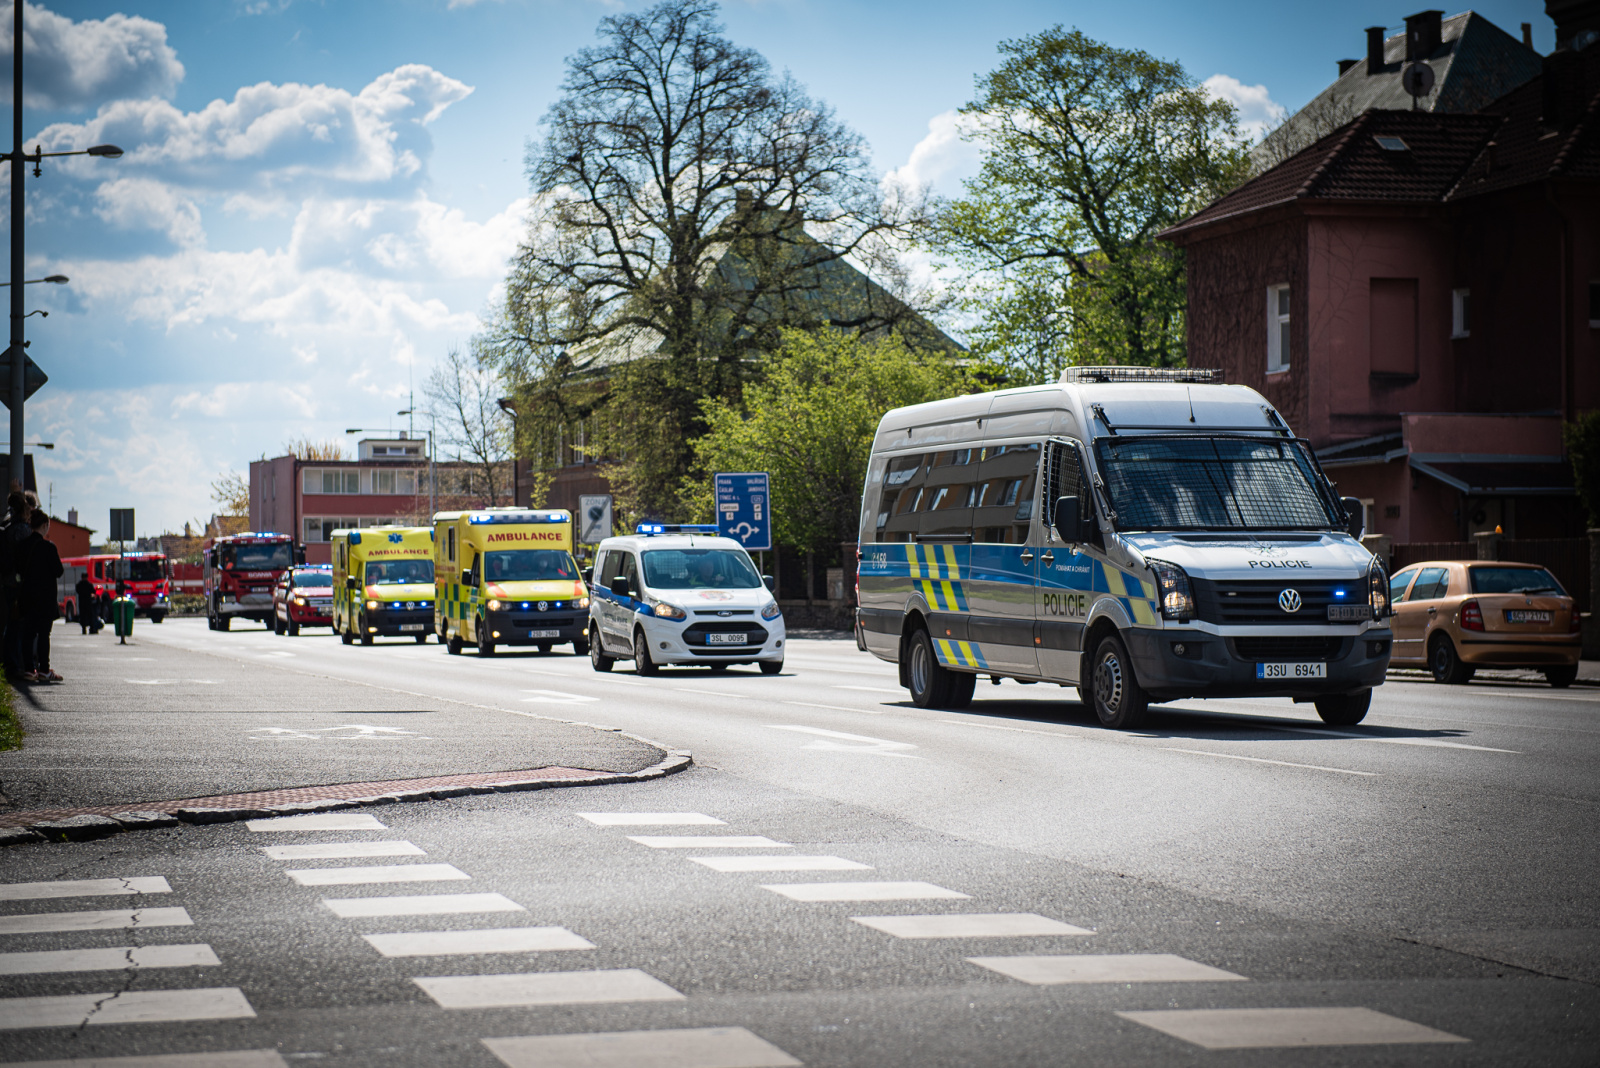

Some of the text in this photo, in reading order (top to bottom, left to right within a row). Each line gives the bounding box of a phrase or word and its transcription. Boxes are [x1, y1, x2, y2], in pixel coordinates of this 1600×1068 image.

[487, 532, 563, 542] AMBULANCE
[368, 548, 429, 556] AMBULANCE
[1248, 560, 1312, 569] POLICIE
[1043, 593, 1086, 617] POLICIE
[1266, 664, 1287, 676] 3SU
[1295, 664, 1321, 676] 6941
